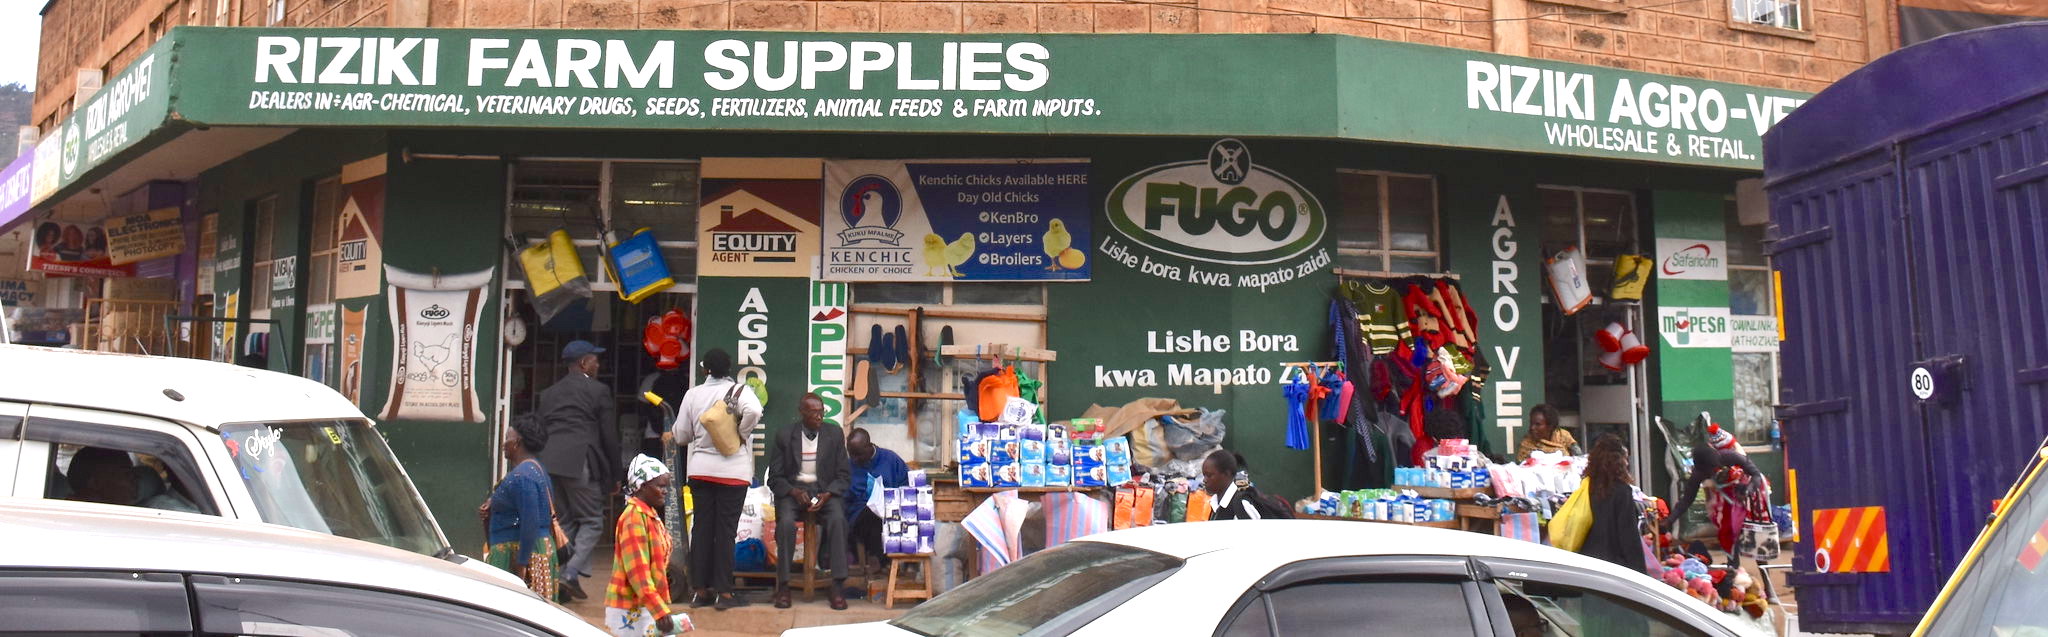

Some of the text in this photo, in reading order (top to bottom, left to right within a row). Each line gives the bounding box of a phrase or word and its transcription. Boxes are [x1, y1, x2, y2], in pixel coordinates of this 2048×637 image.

[254, 36, 1050, 92] RIZIKI FARM SUPPLIES
[1466, 60, 1595, 121] RIZIKI
[249, 91, 312, 110] DEALERS
[476, 95, 577, 114] VETERINARY
[579, 96, 637, 117] DRUGS,
[645, 97, 706, 118] SEEDS,
[711, 98, 809, 119] FERTILIZERS,
[813, 98, 883, 118] ANIMAL
[889, 99, 942, 118] FEEDS
[952, 99, 968, 118] &
[973, 99, 1027, 118] FARM
[1032, 99, 1102, 118] INPUTS.
[1544, 121, 1755, 161] WHOLESALE & RETAIL.
[919, 174, 1088, 185] Kenchic Chicks Available HERE
[957, 192, 1039, 205] Day Old Chicks
[990, 211, 1039, 224] KenBro
[1144, 181, 1298, 242] FUGO
[713, 234, 796, 251] EQUITY
[847, 229, 895, 239] KUKU MFALME
[990, 232, 1033, 247] Layers
[340, 242, 366, 261] EQUITY
[712, 252, 749, 263] AGENT
[831, 251, 911, 263] KENCHIC
[990, 252, 1042, 265] Broilers
[1671, 252, 1719, 268] Safaricom
[1099, 235, 1139, 268] Lishe
[1140, 256, 1182, 281] bora
[1188, 265, 1232, 287] kwa
[1297, 248, 1332, 278] zaidi
[830, 266, 912, 274] CHICKEN OF CHOICE
[1147, 329, 1299, 353] Lishe Bora
[1094, 365, 1158, 388] kwa
[1167, 363, 1271, 394] Mapato
[1915, 373, 1930, 391] 80
